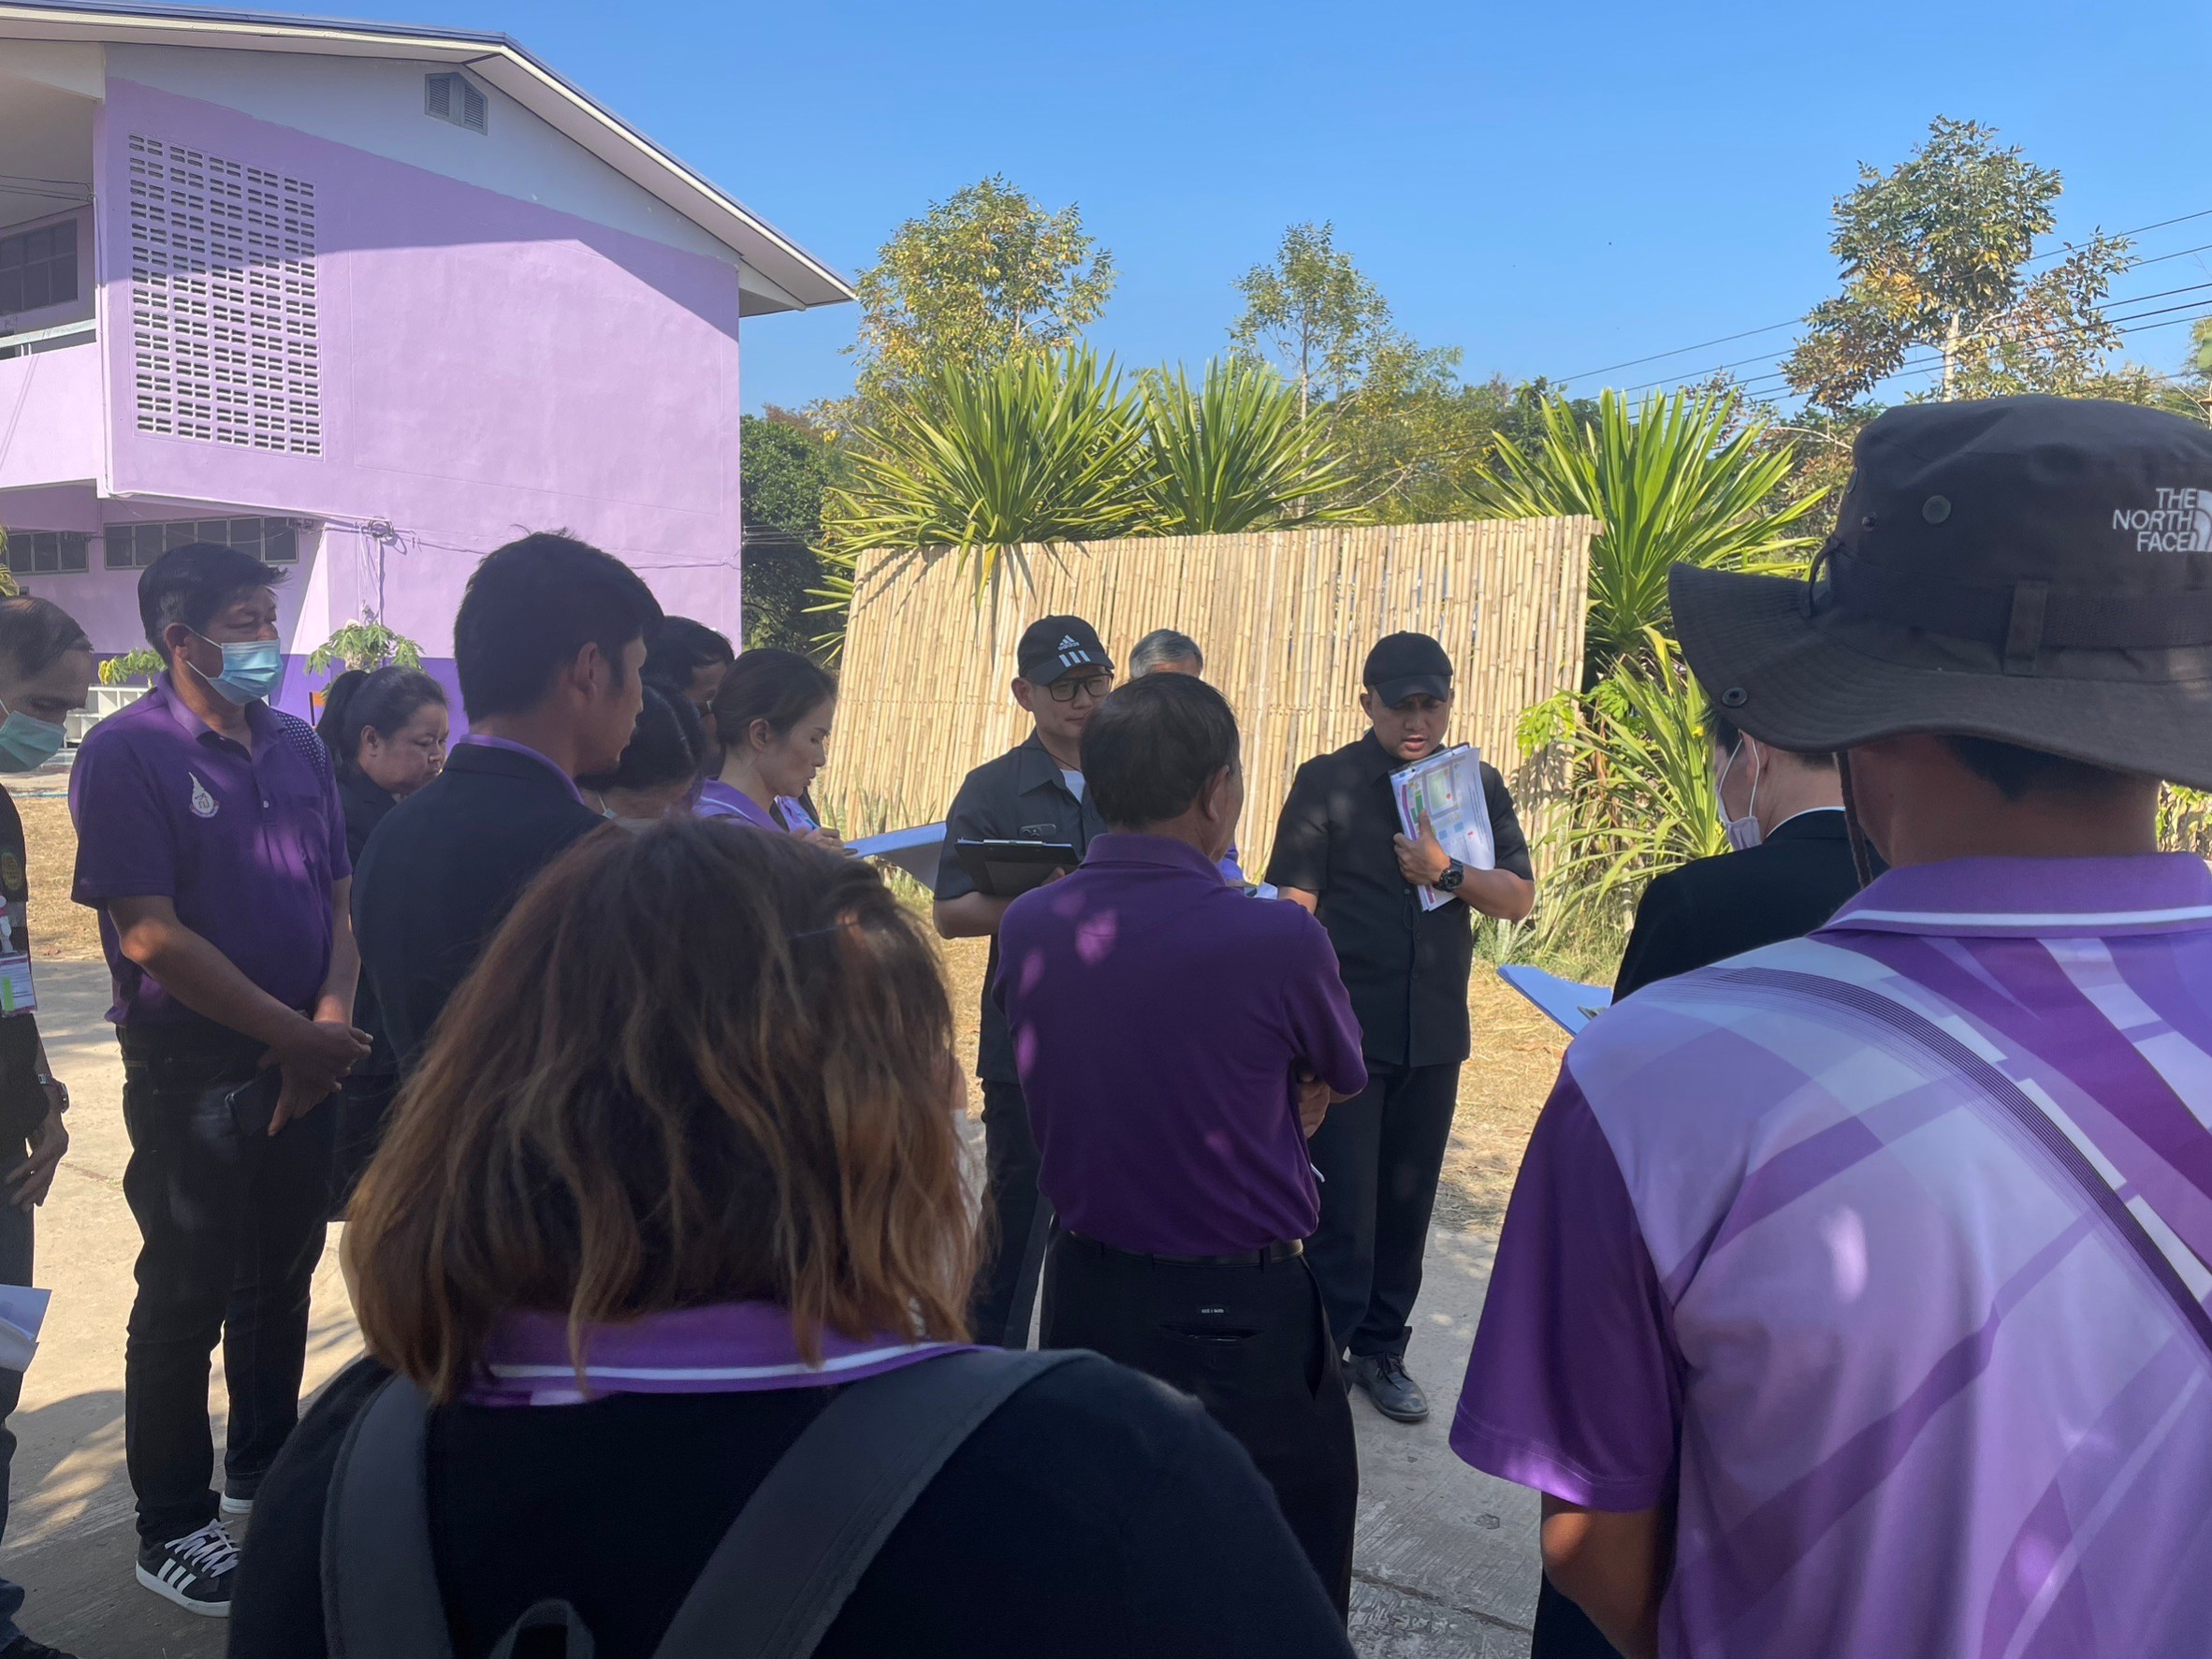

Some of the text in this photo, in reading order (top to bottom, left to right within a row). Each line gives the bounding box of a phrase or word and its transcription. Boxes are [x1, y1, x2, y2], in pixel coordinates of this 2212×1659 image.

[2156, 488, 2197, 509] THE
[2113, 509, 2194, 531] NORTH
[2137, 531, 2190, 552] FACE
